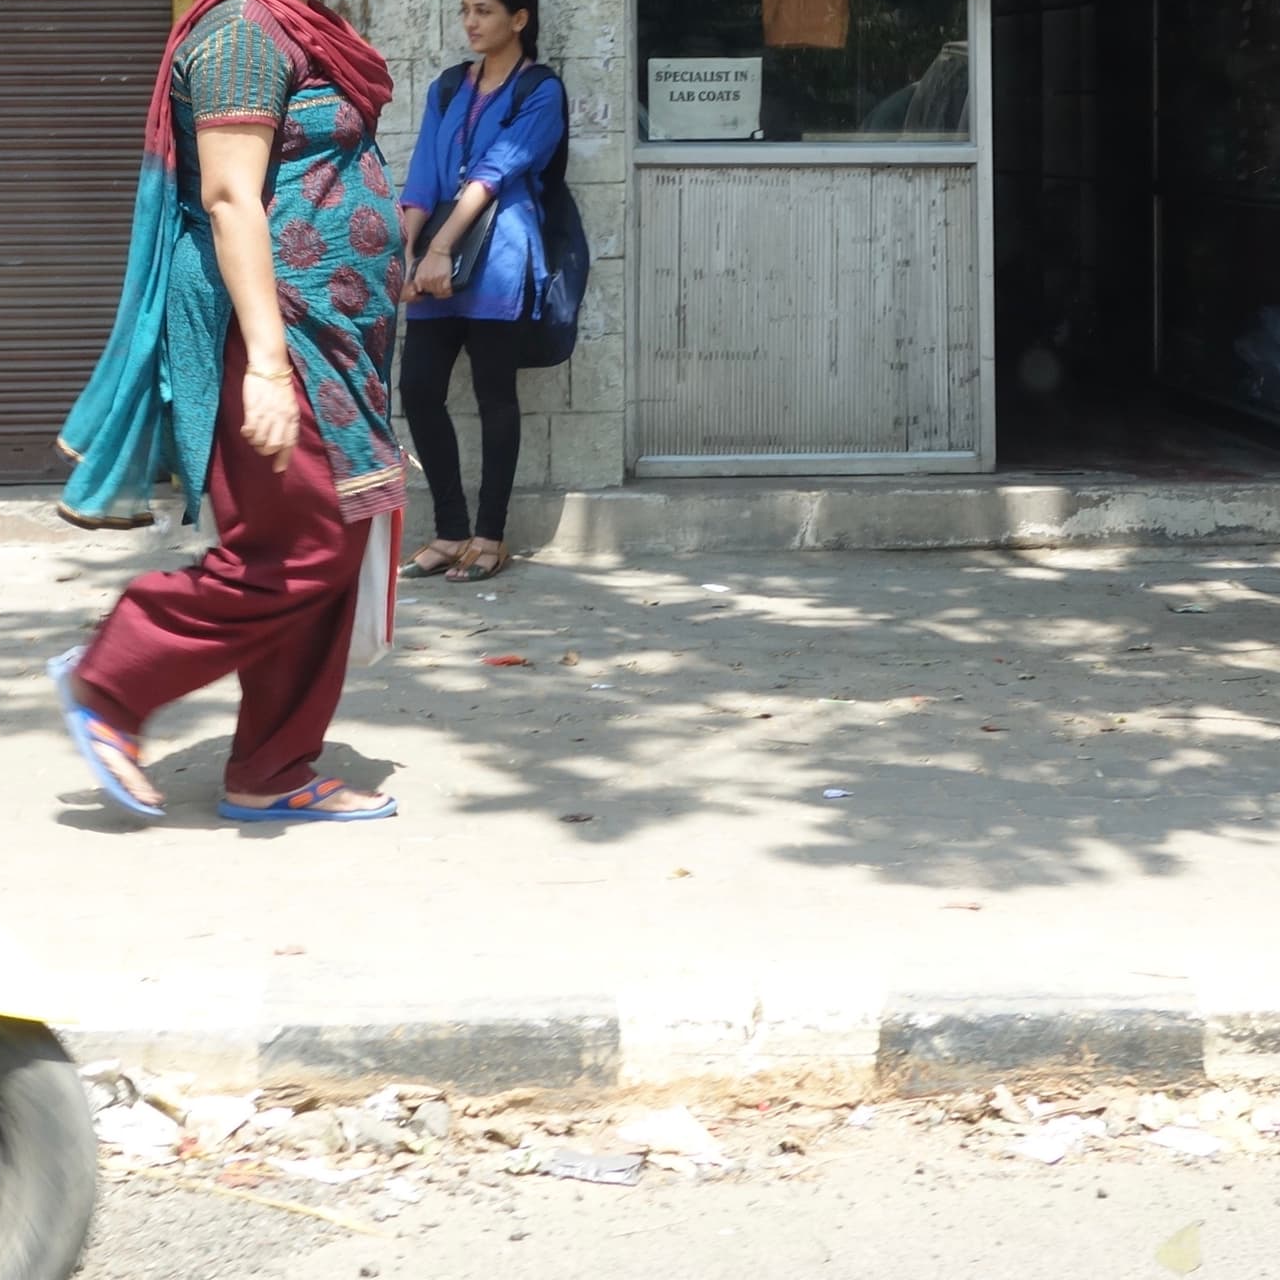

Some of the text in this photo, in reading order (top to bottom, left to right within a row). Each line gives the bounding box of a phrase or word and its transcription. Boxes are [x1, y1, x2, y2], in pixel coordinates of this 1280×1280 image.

[655, 70, 748, 83] SPECIALIST IN
[669, 90, 742, 103] LAB COATS
